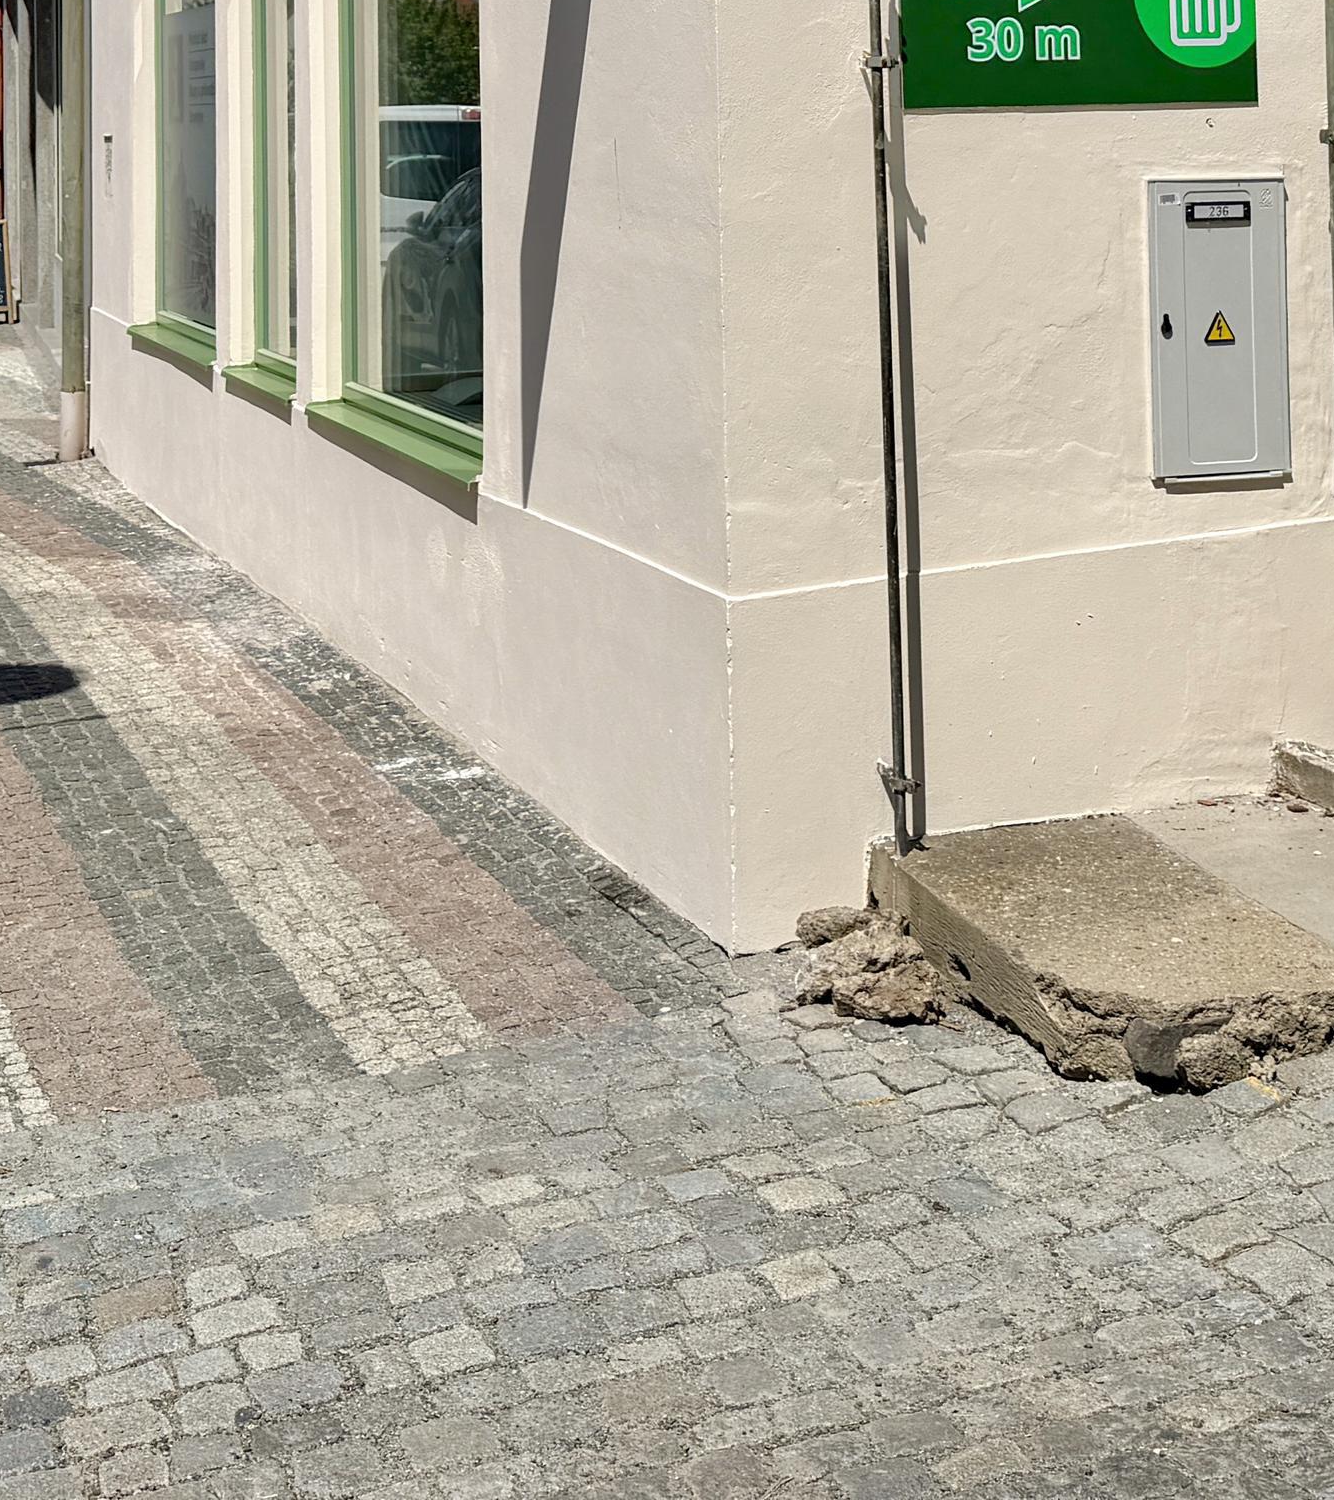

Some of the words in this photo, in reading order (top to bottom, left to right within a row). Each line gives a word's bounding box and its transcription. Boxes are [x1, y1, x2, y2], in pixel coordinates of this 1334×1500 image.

[966, 17, 1024, 61] 30
[1035, 23, 1081, 61] m
[1209, 206, 1229, 217] 236
